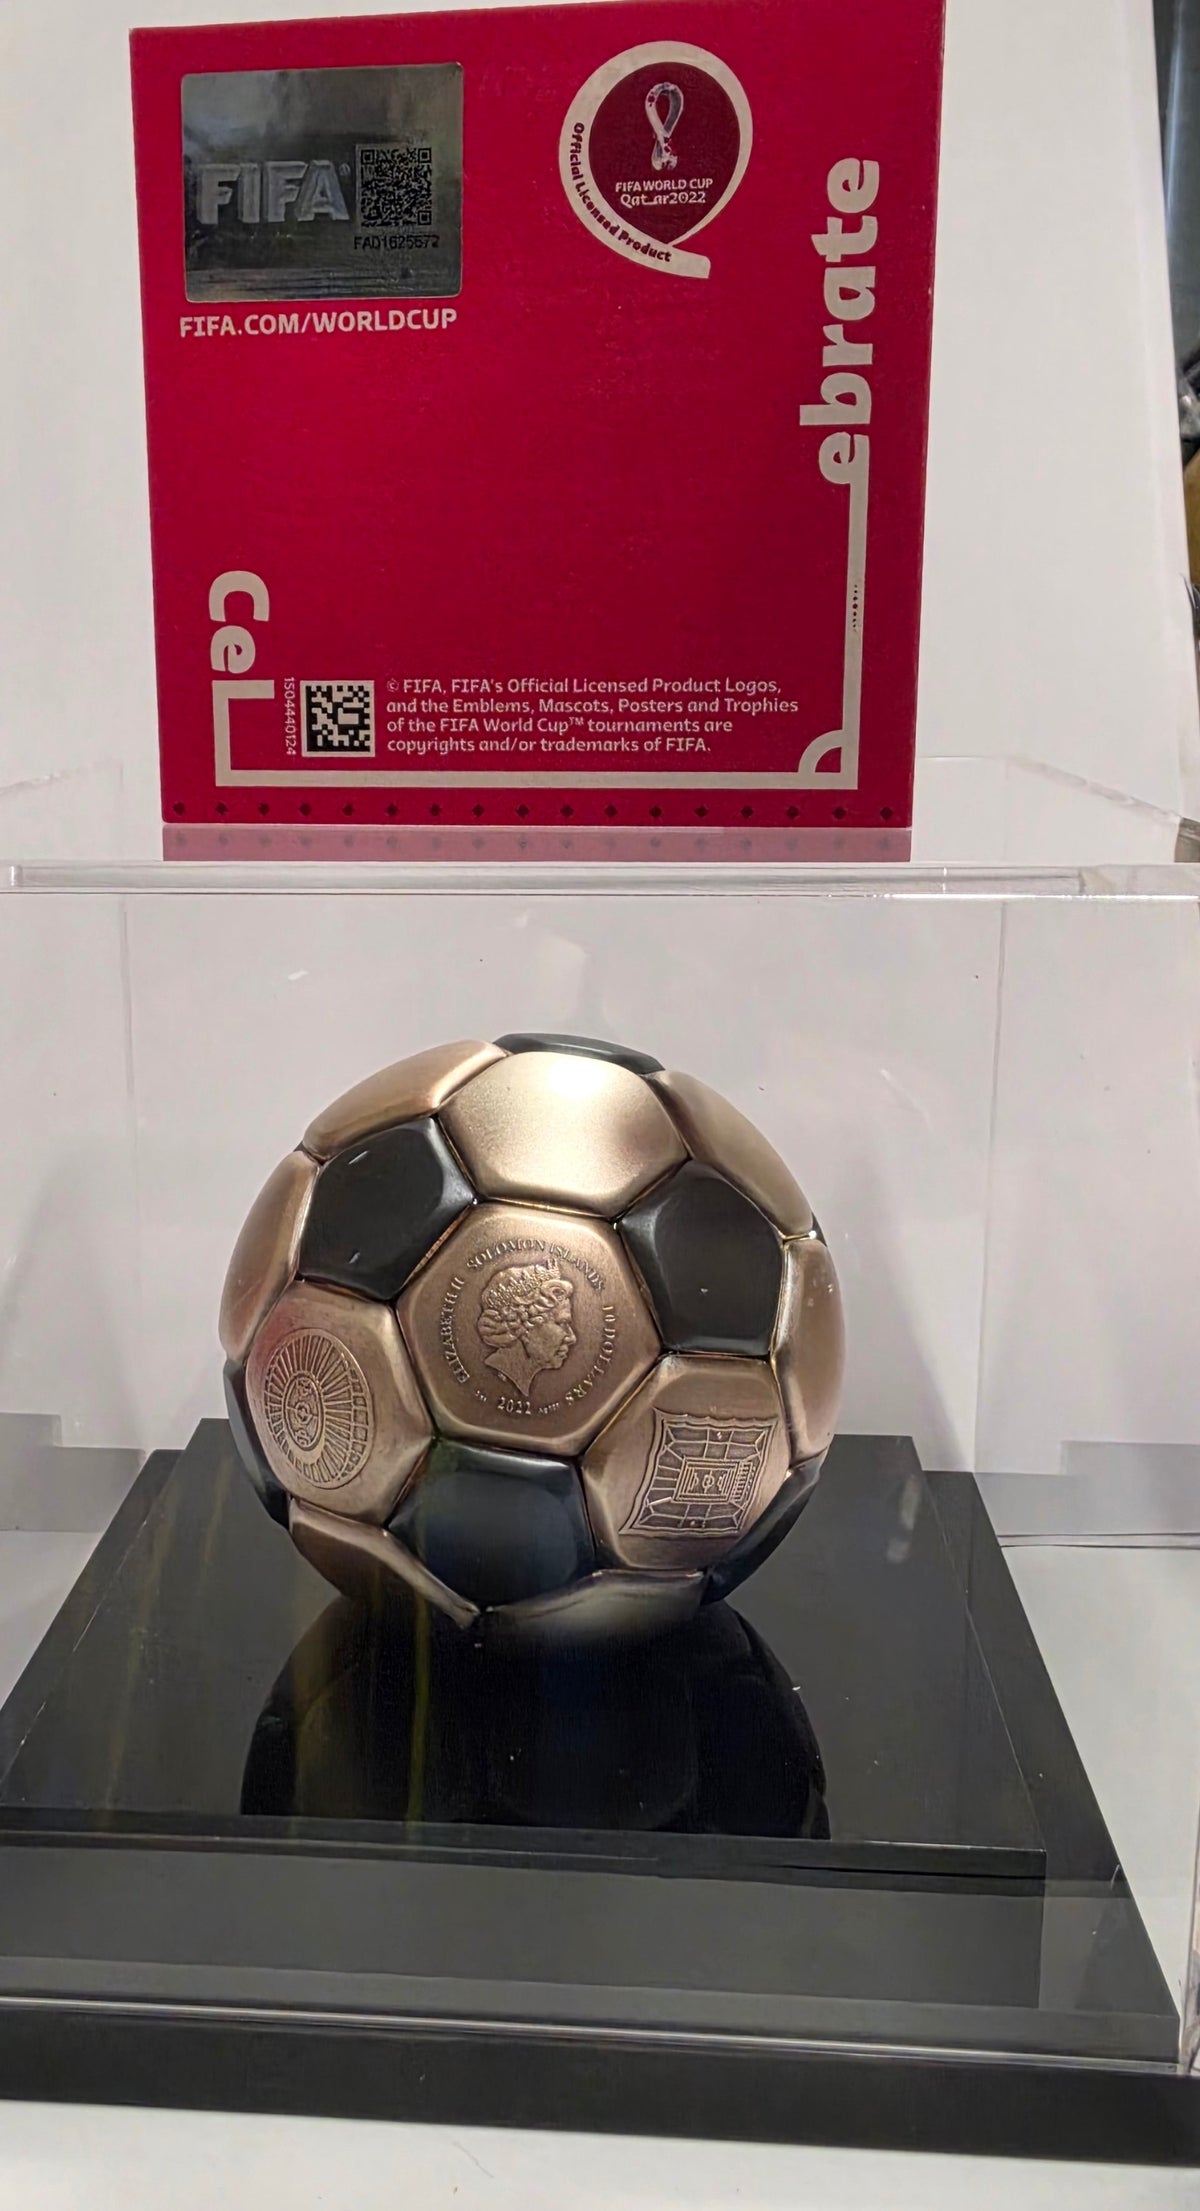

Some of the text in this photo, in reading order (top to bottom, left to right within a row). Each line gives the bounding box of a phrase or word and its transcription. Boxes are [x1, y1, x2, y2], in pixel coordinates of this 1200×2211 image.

[570, 122, 672, 262] Official Licensed Product
[614, 178, 713, 193] FIFA WORLD CUP
[179, 308, 458, 338] FIFA.COM/WORLDCUP
[403, 679, 447, 695] FIFA,
[451, 678, 503, 693] FIFA's
[507, 678, 568, 693] Official
[573, 678, 648, 693] Licensed
[652, 677, 721, 693] Product
[725, 677, 781, 696] Logos,
[386, 698, 799, 716] and the Emblems, Mascots, Posters and Trophies
[387, 717, 405, 732] of
[408, 718, 436, 732] the
[440, 717, 479, 732] FIFA
[483, 718, 533, 732] World
[588, 718, 700, 732] tournaments
[704, 720, 733, 732] are
[387, 737, 711, 755] copyrights and/or trademarks of FIFA.
[466, 1239, 606, 1292] SOLOMON ISLANDS
[565, 1328, 616, 1407] DOLLARS
[497, 1396, 532, 1415] 2022
